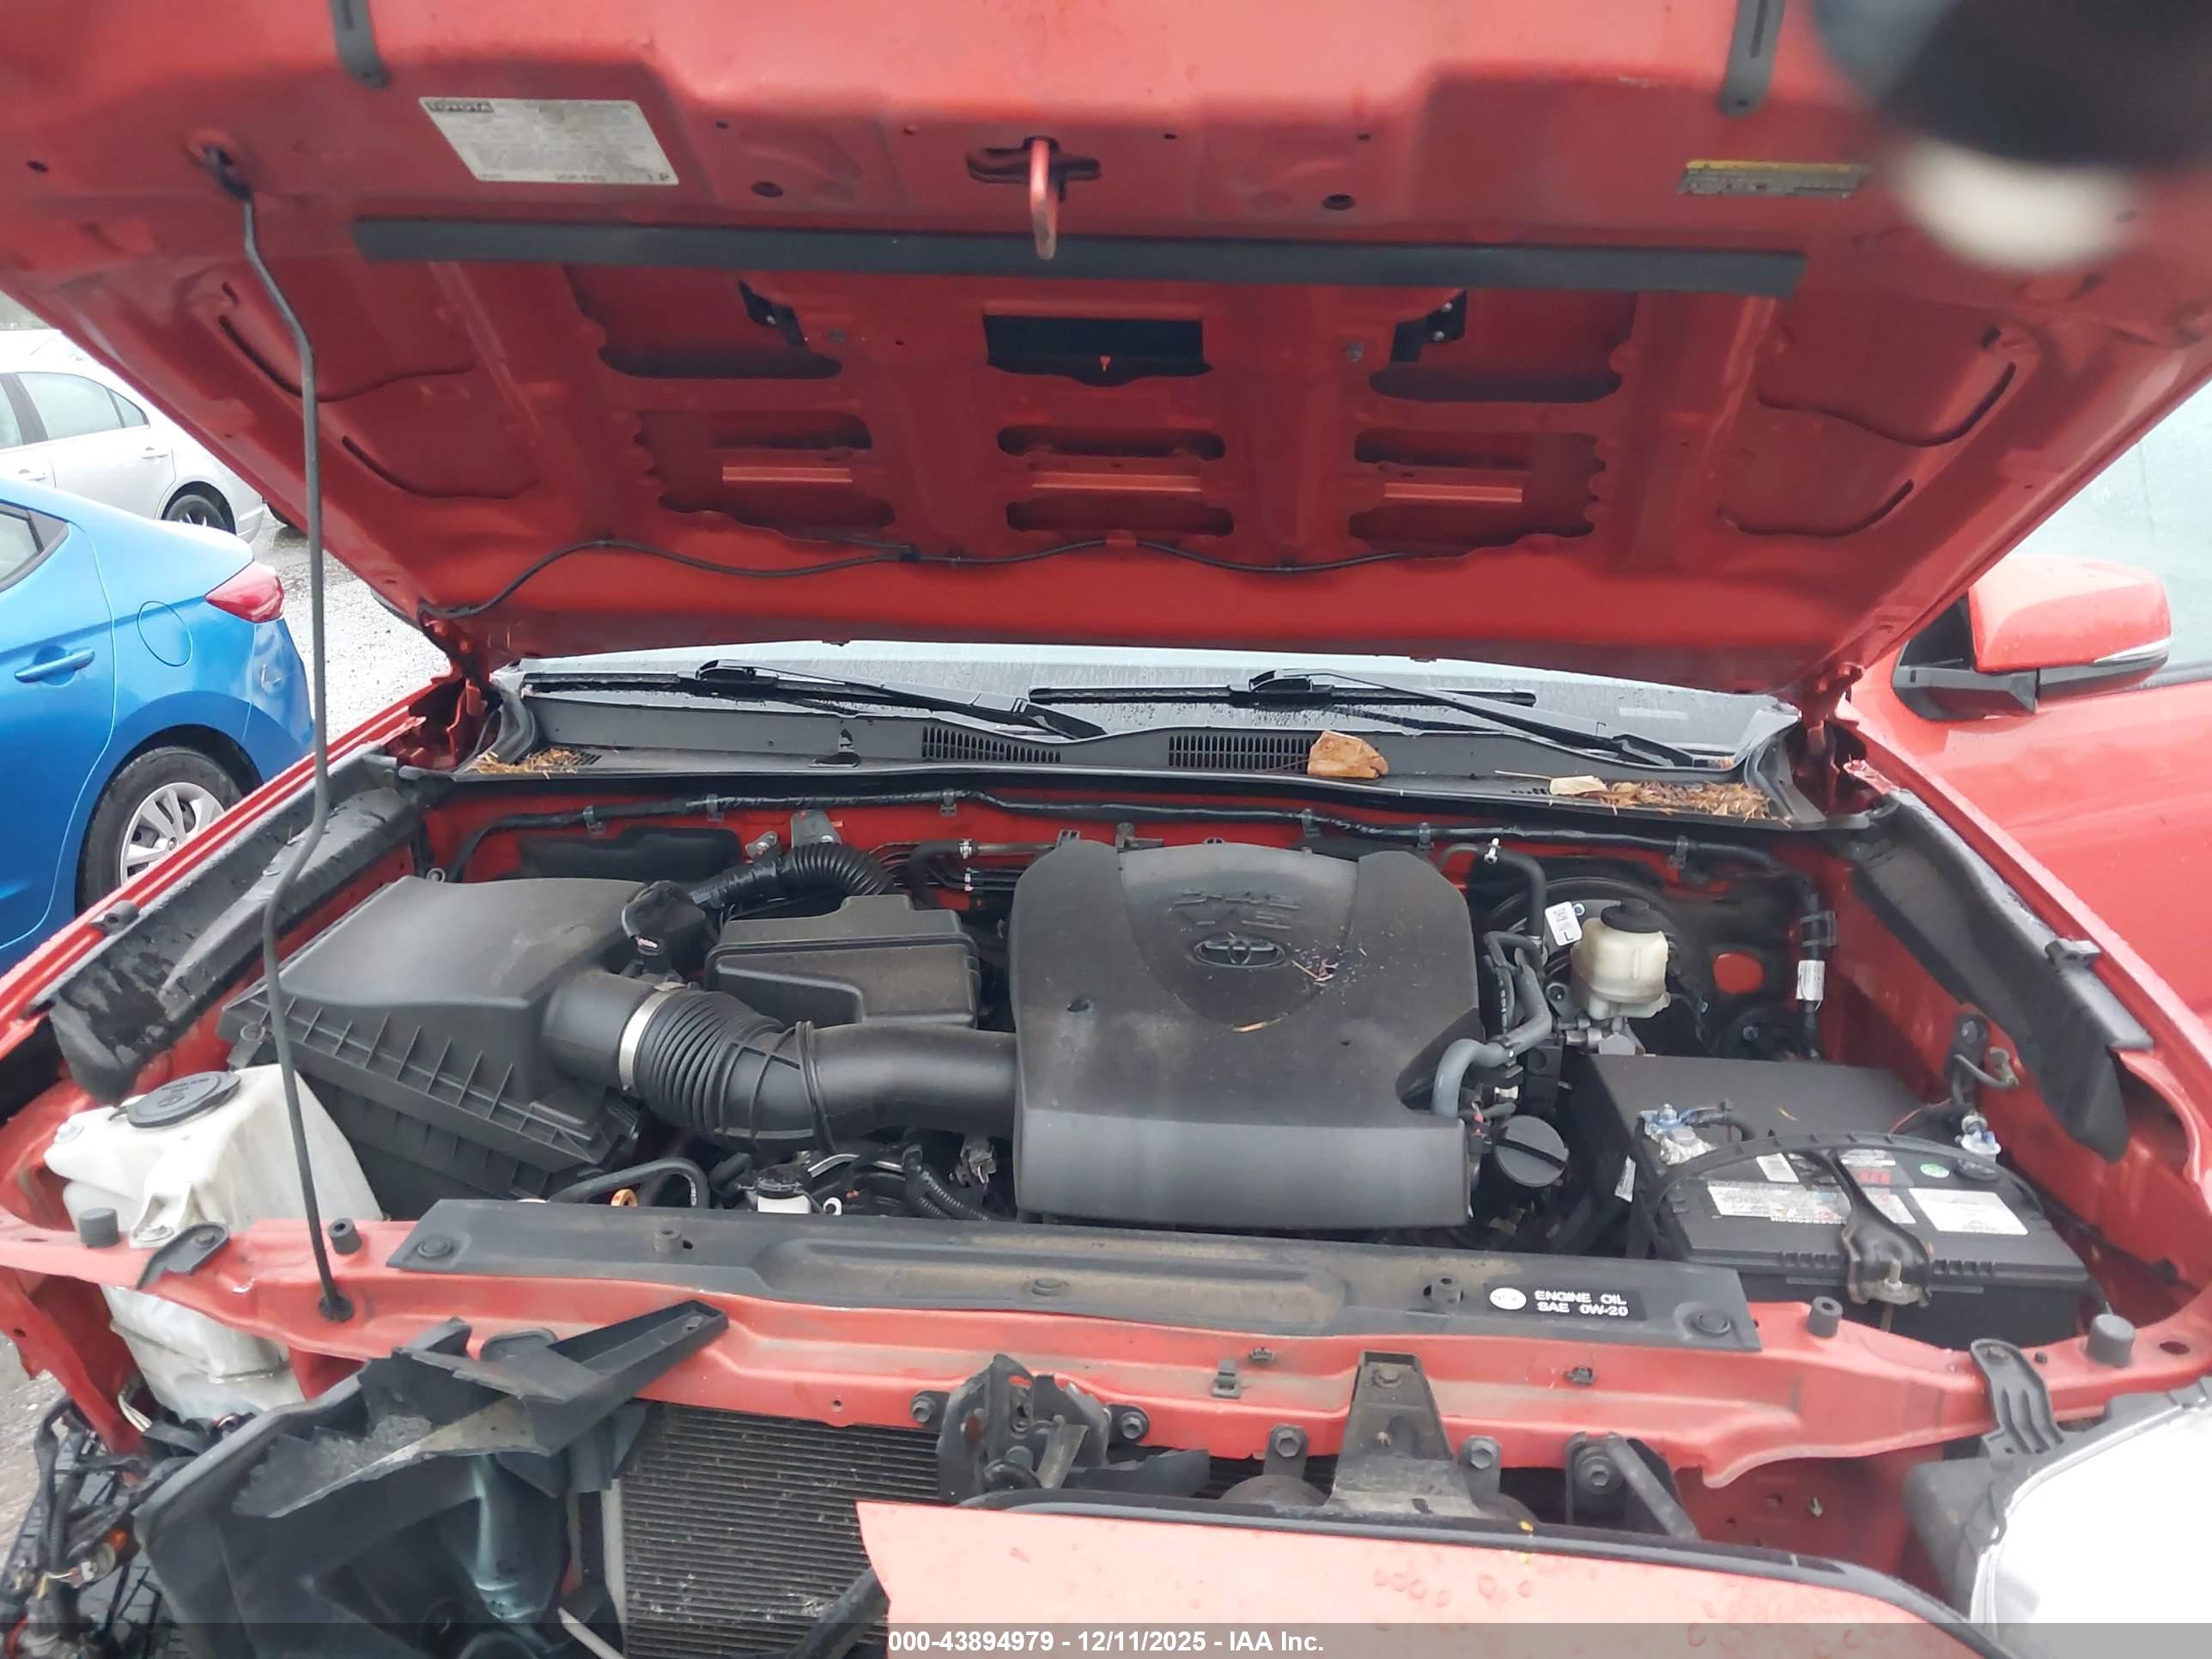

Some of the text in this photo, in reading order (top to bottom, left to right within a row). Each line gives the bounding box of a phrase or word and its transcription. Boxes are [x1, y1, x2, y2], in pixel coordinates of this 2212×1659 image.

[1534, 1291, 1627, 1304] ENGINE OIL
[1537, 1302, 1629, 1316] SAE 0W-20
